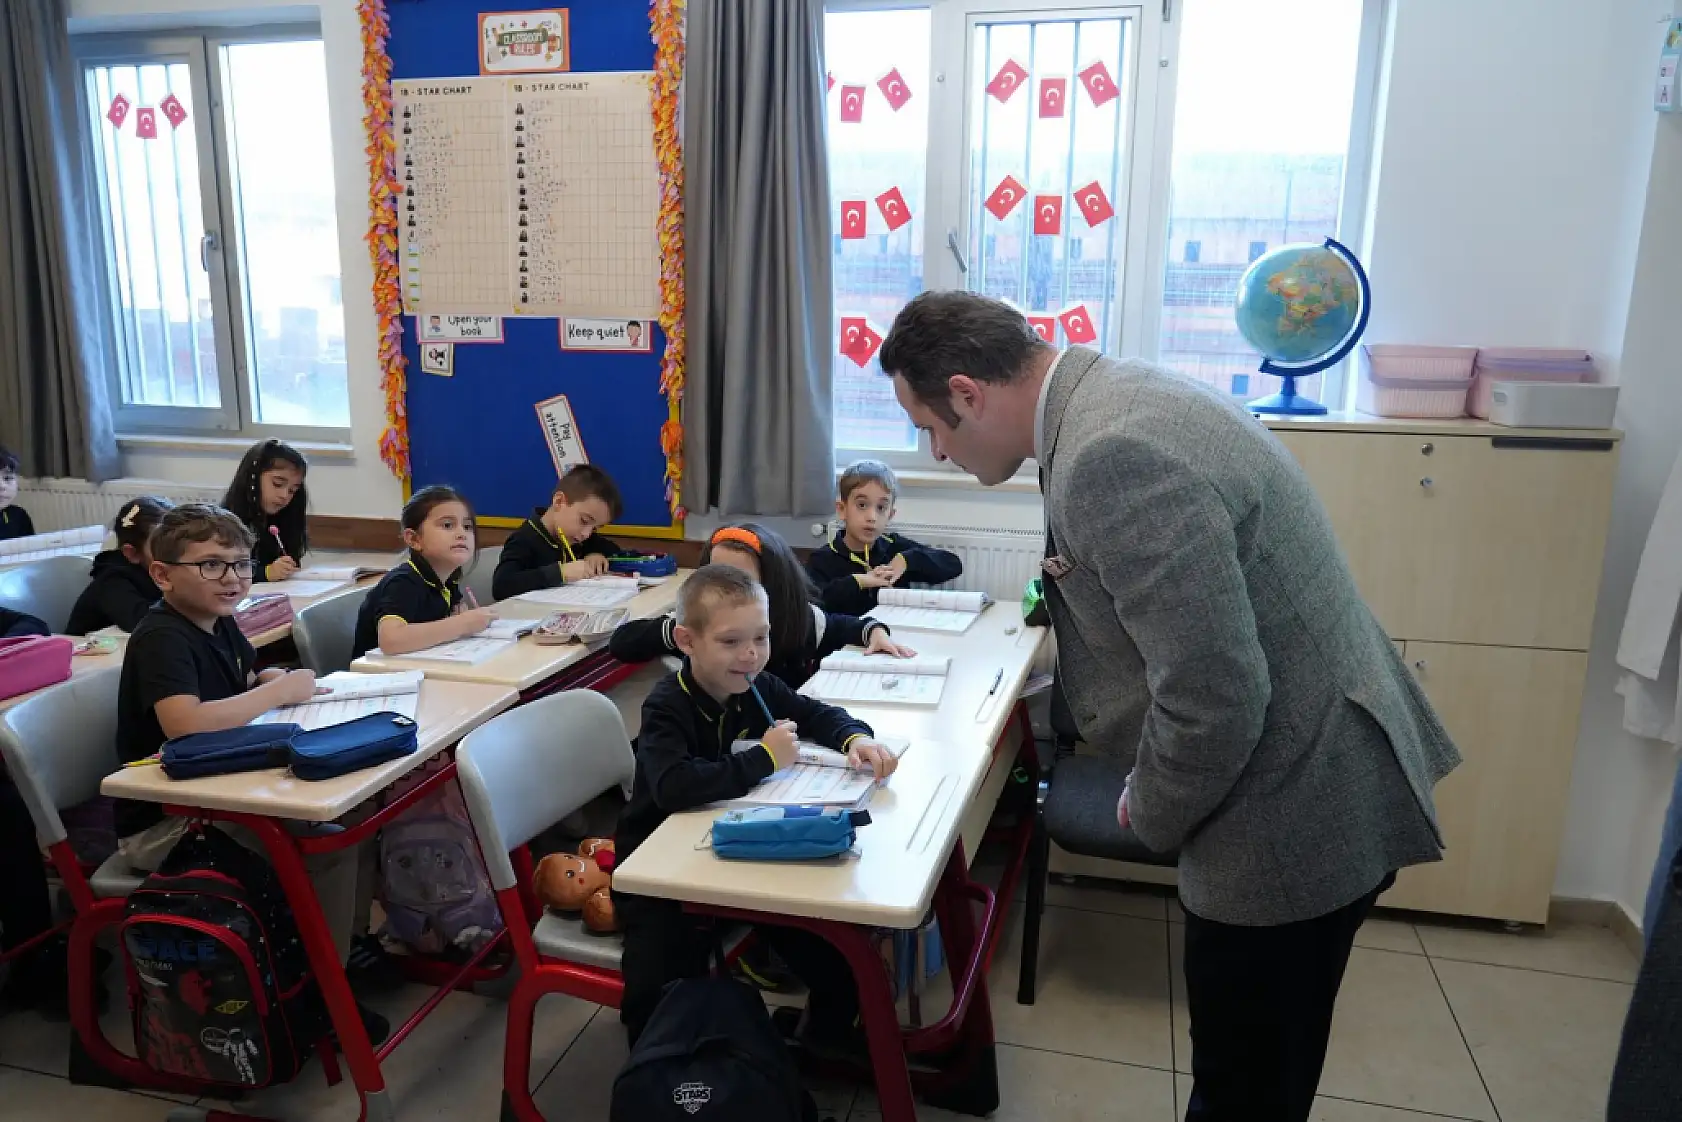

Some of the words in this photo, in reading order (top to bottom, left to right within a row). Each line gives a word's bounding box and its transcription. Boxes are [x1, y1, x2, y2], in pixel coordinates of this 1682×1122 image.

[417, 87, 440, 96] STAR
[443, 86, 472, 96] CHART
[532, 83, 555, 92] STAR
[558, 82, 589, 91] CHART
[473, 315, 492, 325] your
[461, 326, 482, 336] book
[568, 323, 594, 340] Keep
[597, 324, 625, 341] quiet
[546, 412, 567, 459] attention
